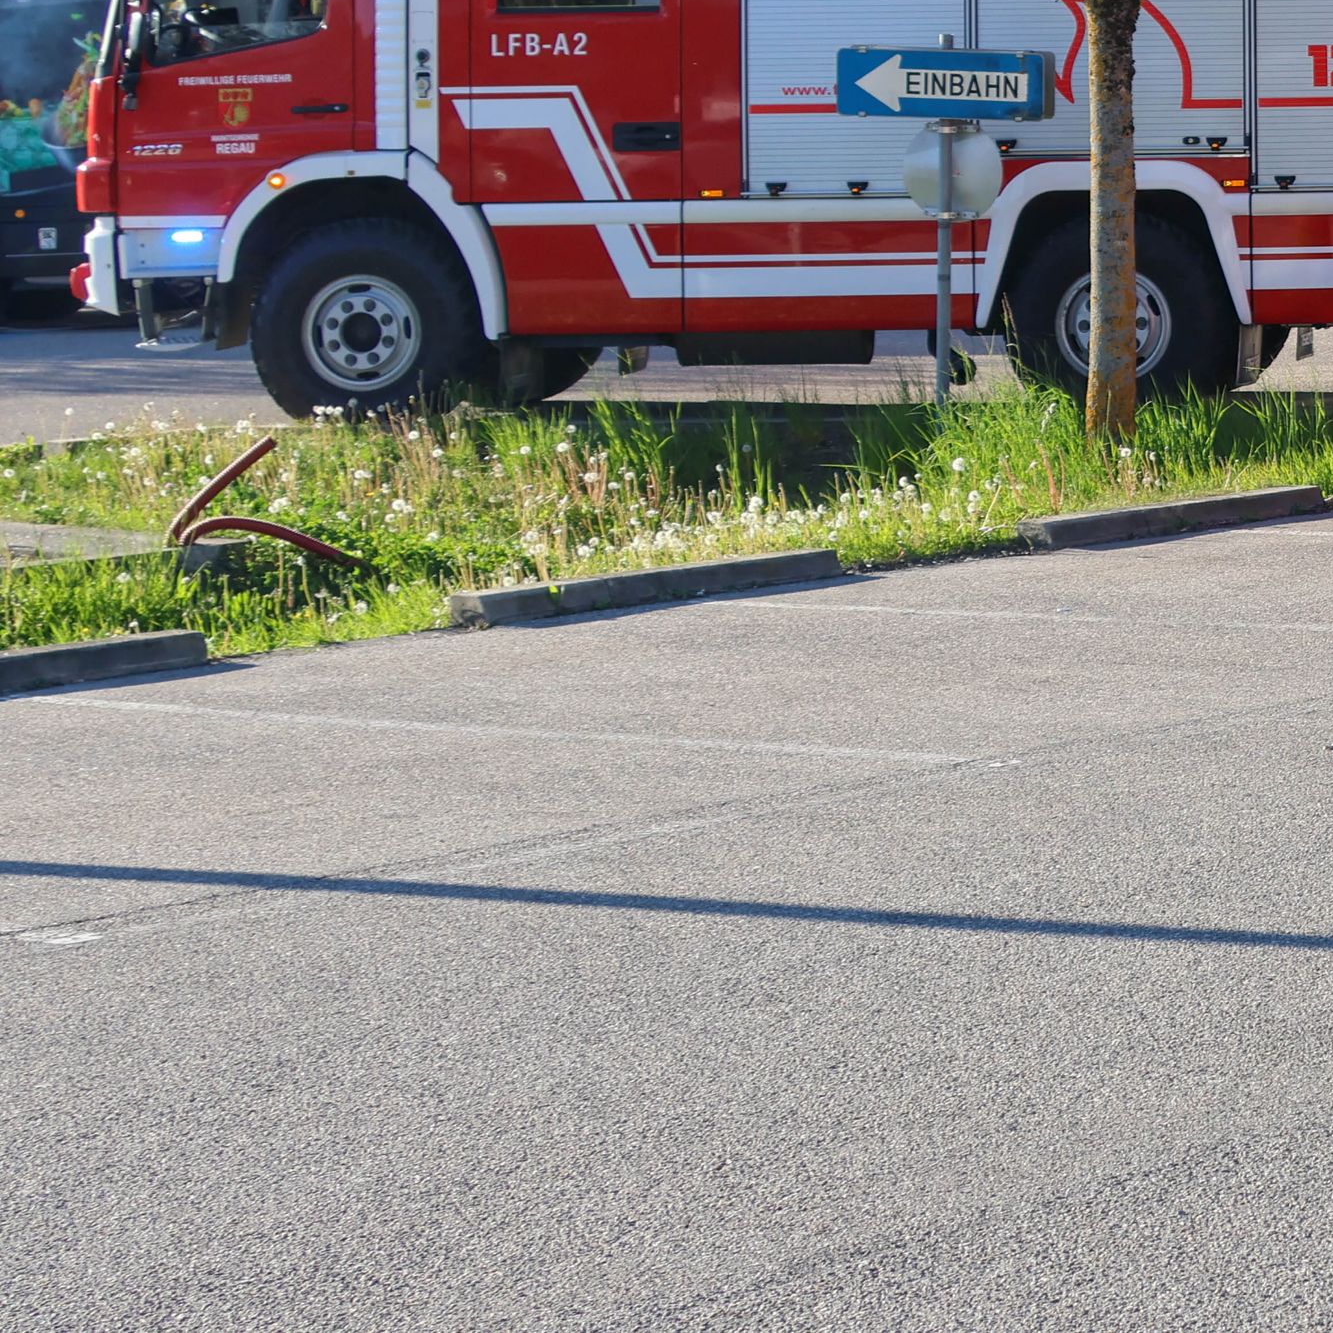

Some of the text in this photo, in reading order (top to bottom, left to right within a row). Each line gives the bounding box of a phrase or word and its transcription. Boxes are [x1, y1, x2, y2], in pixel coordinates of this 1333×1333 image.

[491, 32, 588, 57] LFB-A2
[906, 71, 1019, 99] EINBAHN
[216, 143, 256, 155] REGAU
